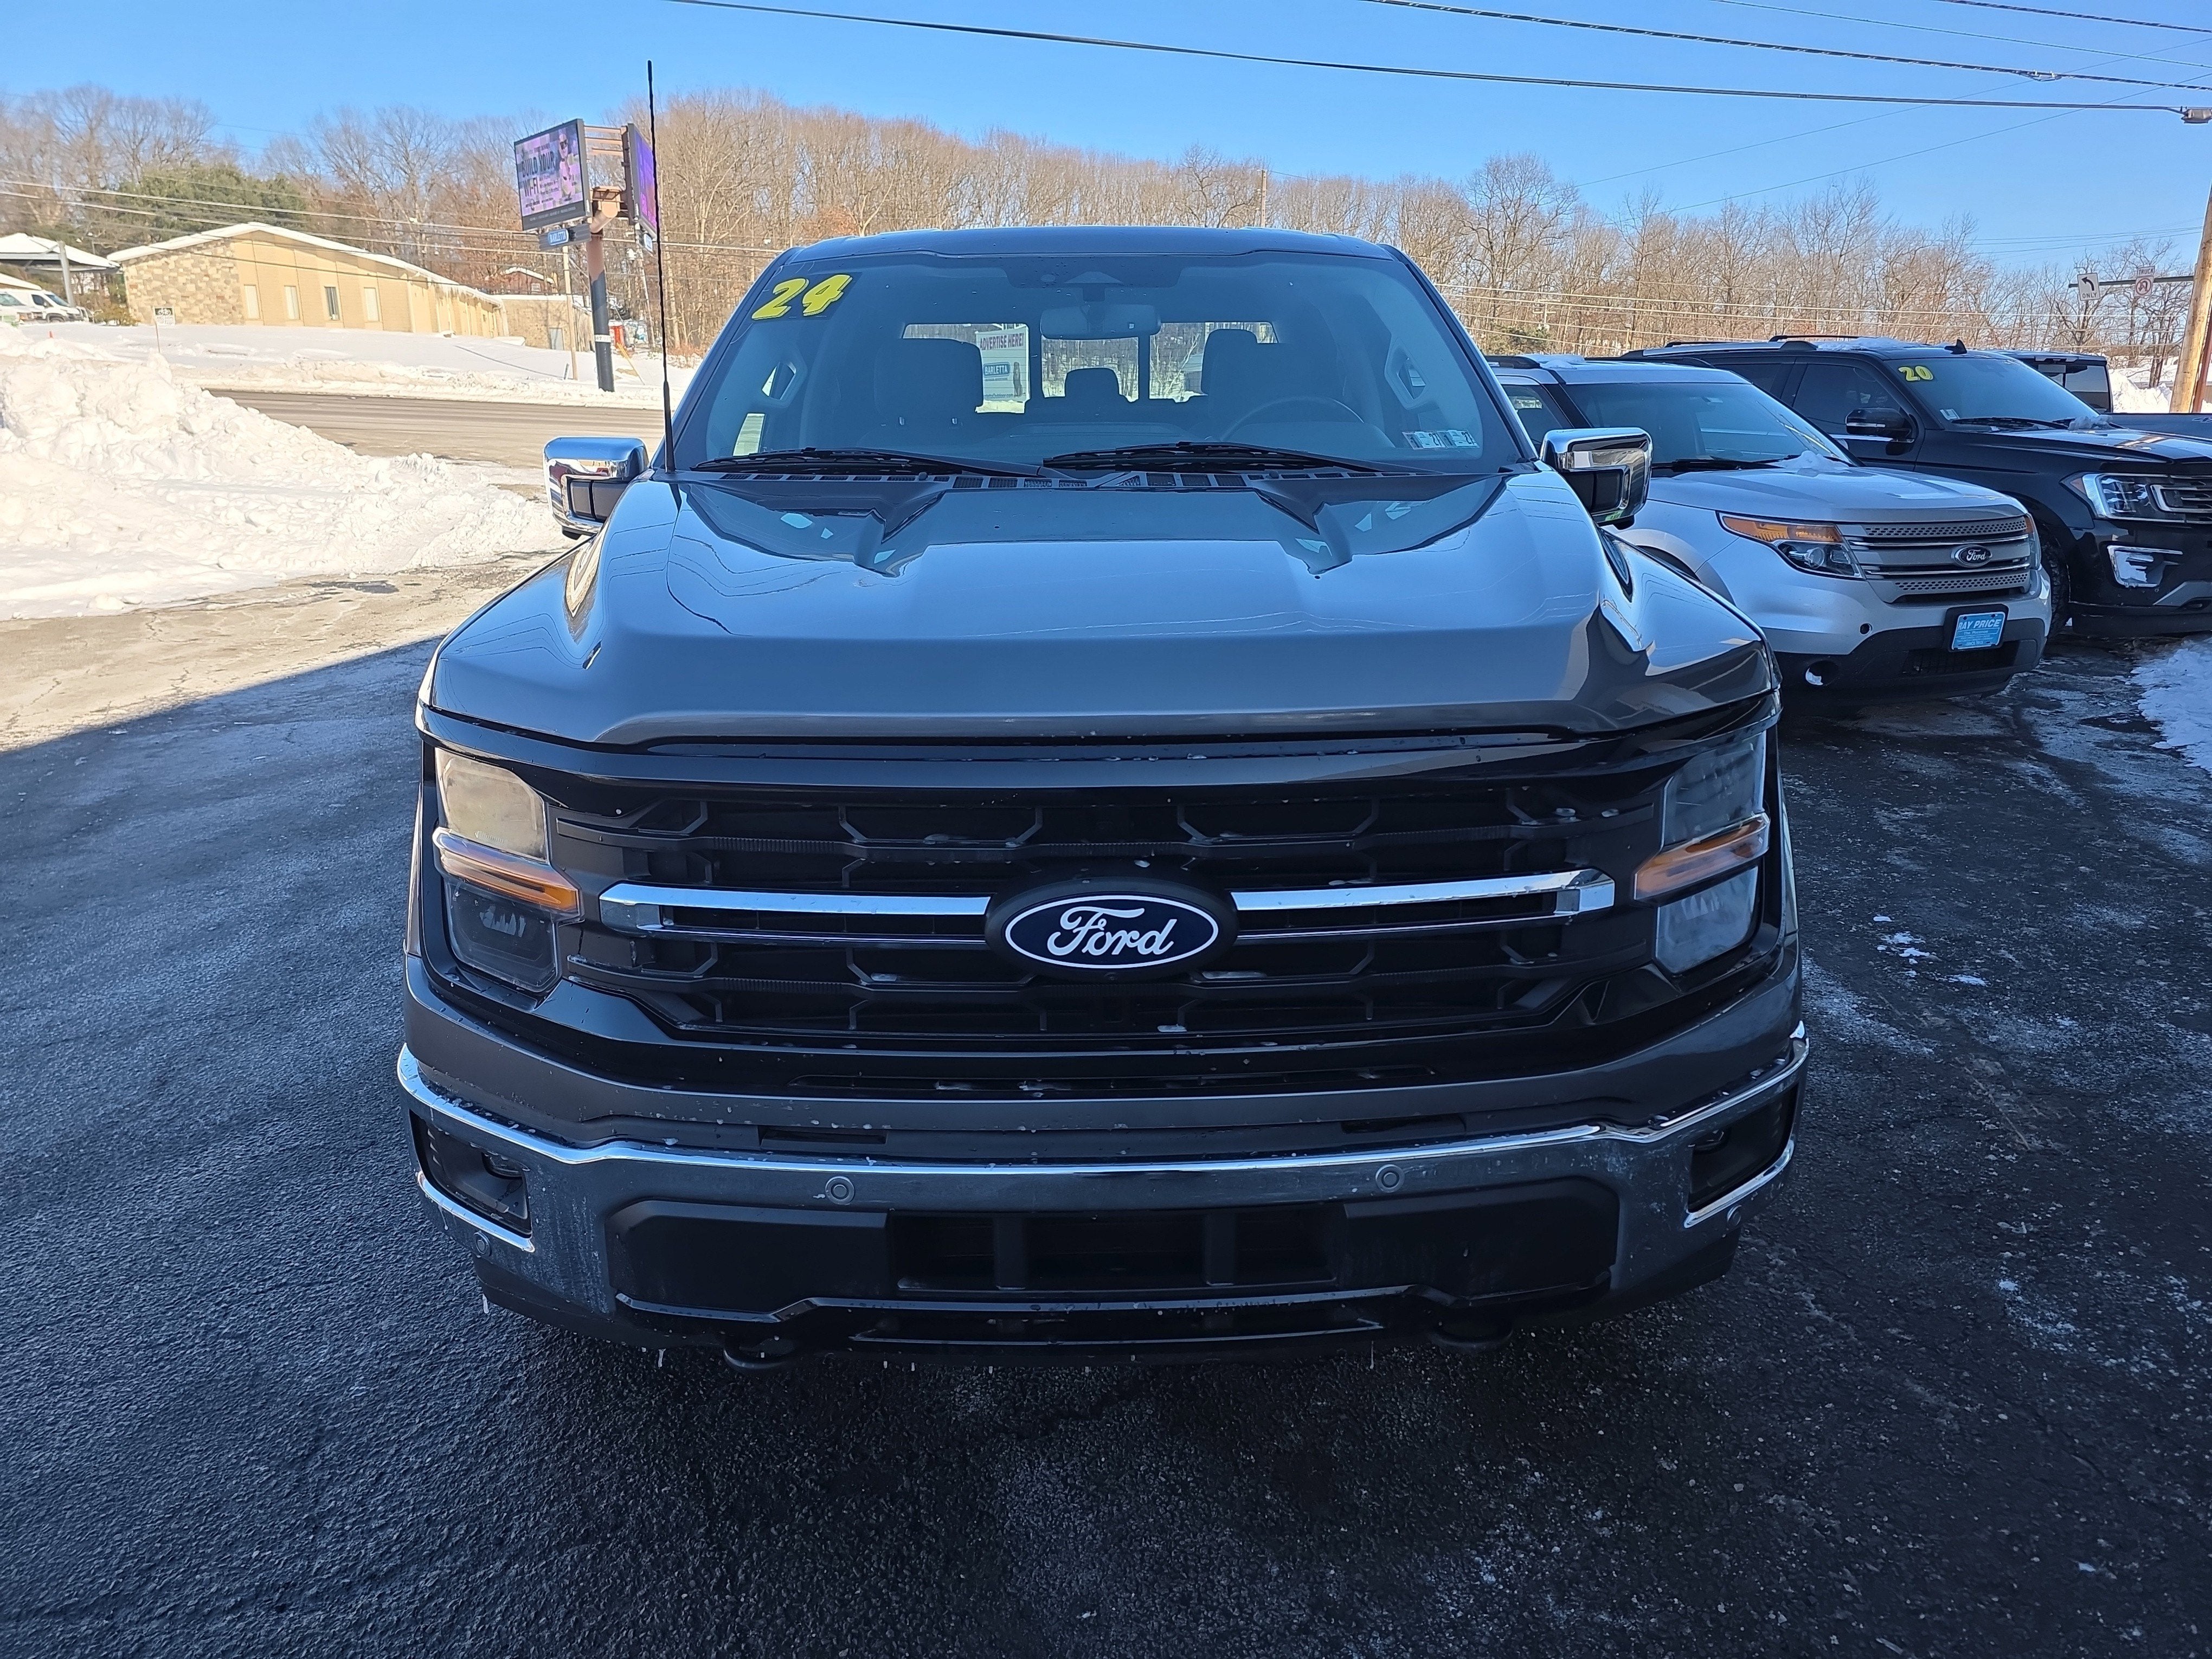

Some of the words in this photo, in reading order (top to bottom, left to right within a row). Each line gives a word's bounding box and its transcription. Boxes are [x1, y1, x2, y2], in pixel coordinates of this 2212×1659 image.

[538, 151, 556, 172] YOUR
[523, 177, 539, 197] WI-FI
[751, 274, 853, 320] 24
[980, 335, 1007, 350] ADVERTISE
[1008, 333, 1024, 348] HERE!
[985, 365, 1008, 375] BARLETTA
[1899, 366, 1934, 382] 20
[1429, 433, 1442, 446] 27
[1443, 434, 1453, 446] 1
[1461, 432, 1475, 445] 27
[1966, 549, 1986, 561] Ford
[1958, 621, 1973, 630] RAY
[1973, 619, 2002, 628] PRICE
[1046, 906, 1178, 956] Ford
